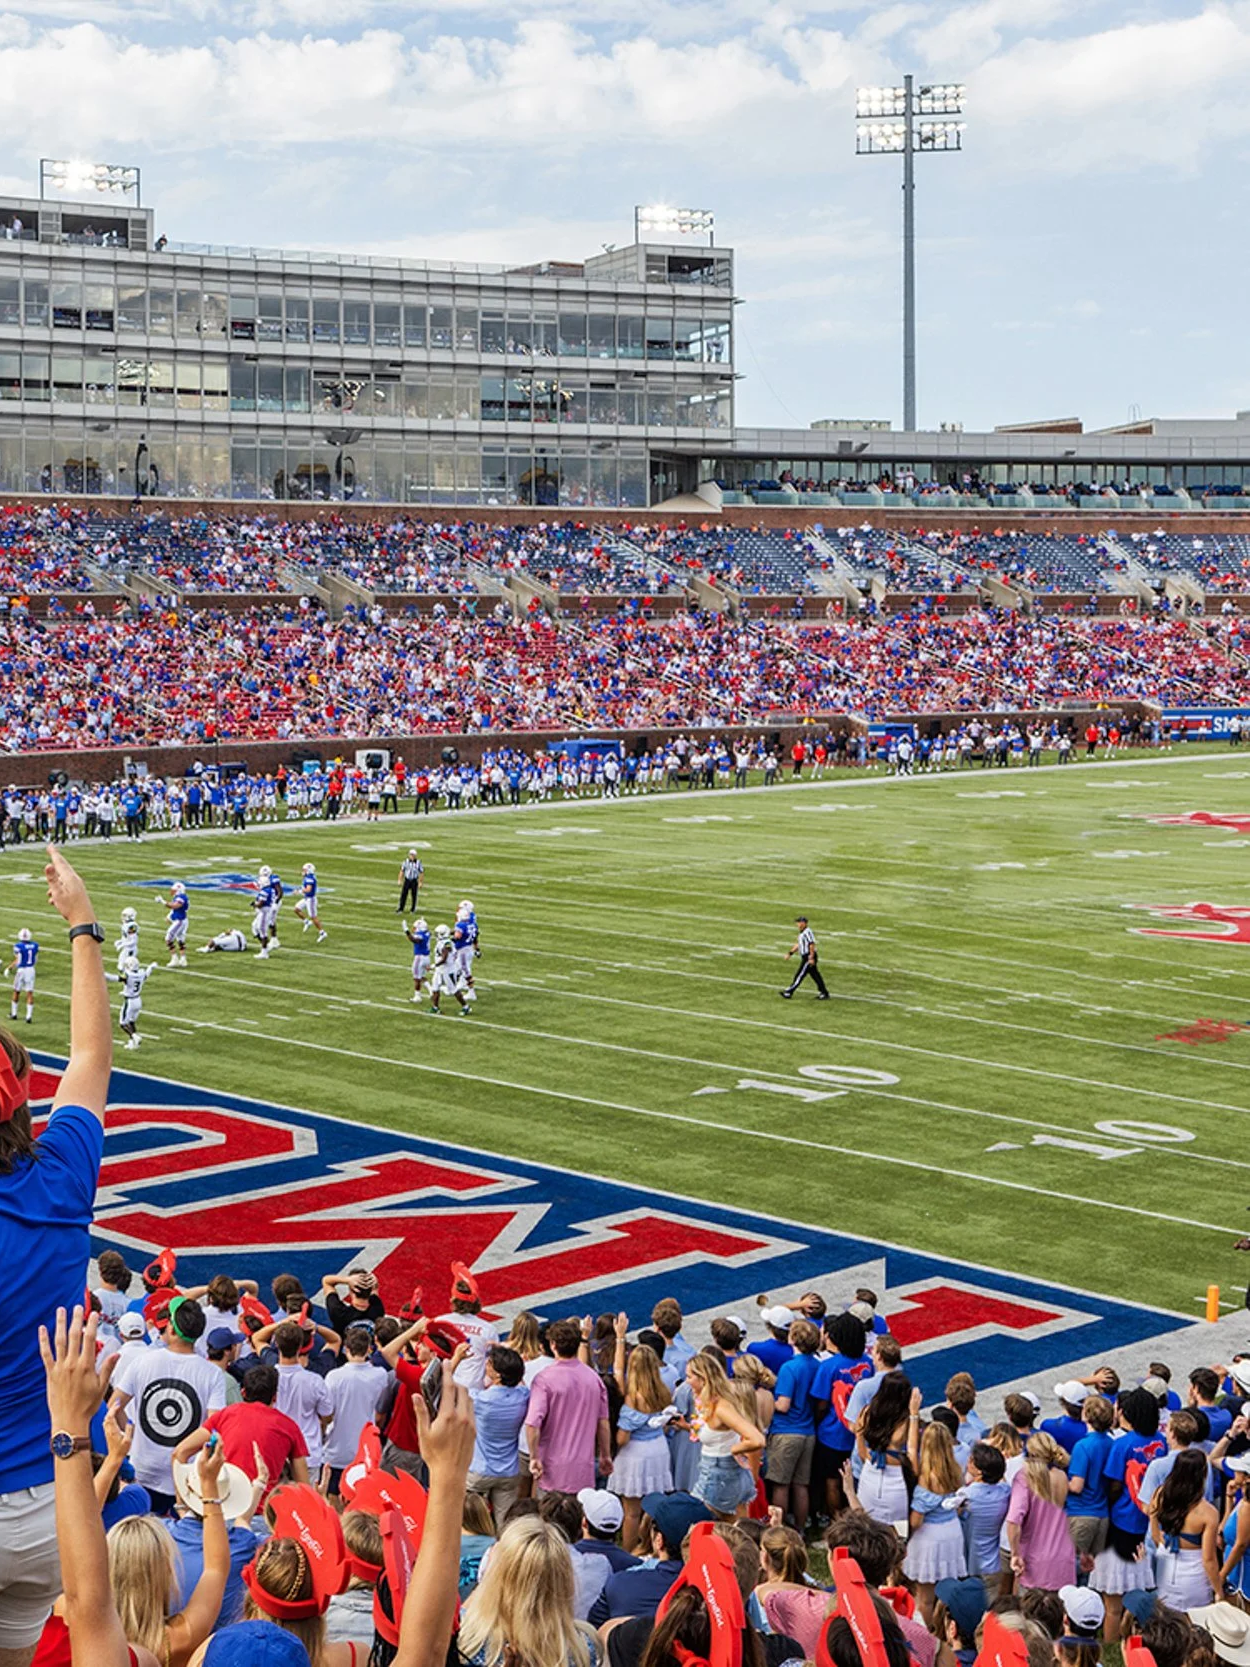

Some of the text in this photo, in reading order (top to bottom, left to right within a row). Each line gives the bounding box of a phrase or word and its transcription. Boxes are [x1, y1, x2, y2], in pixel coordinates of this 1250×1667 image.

[26, 949, 33, 965] 1
[133, 980, 141, 993] 3
[735, 1065, 901, 1103] 10
[1029, 1119, 1197, 1161] 10
